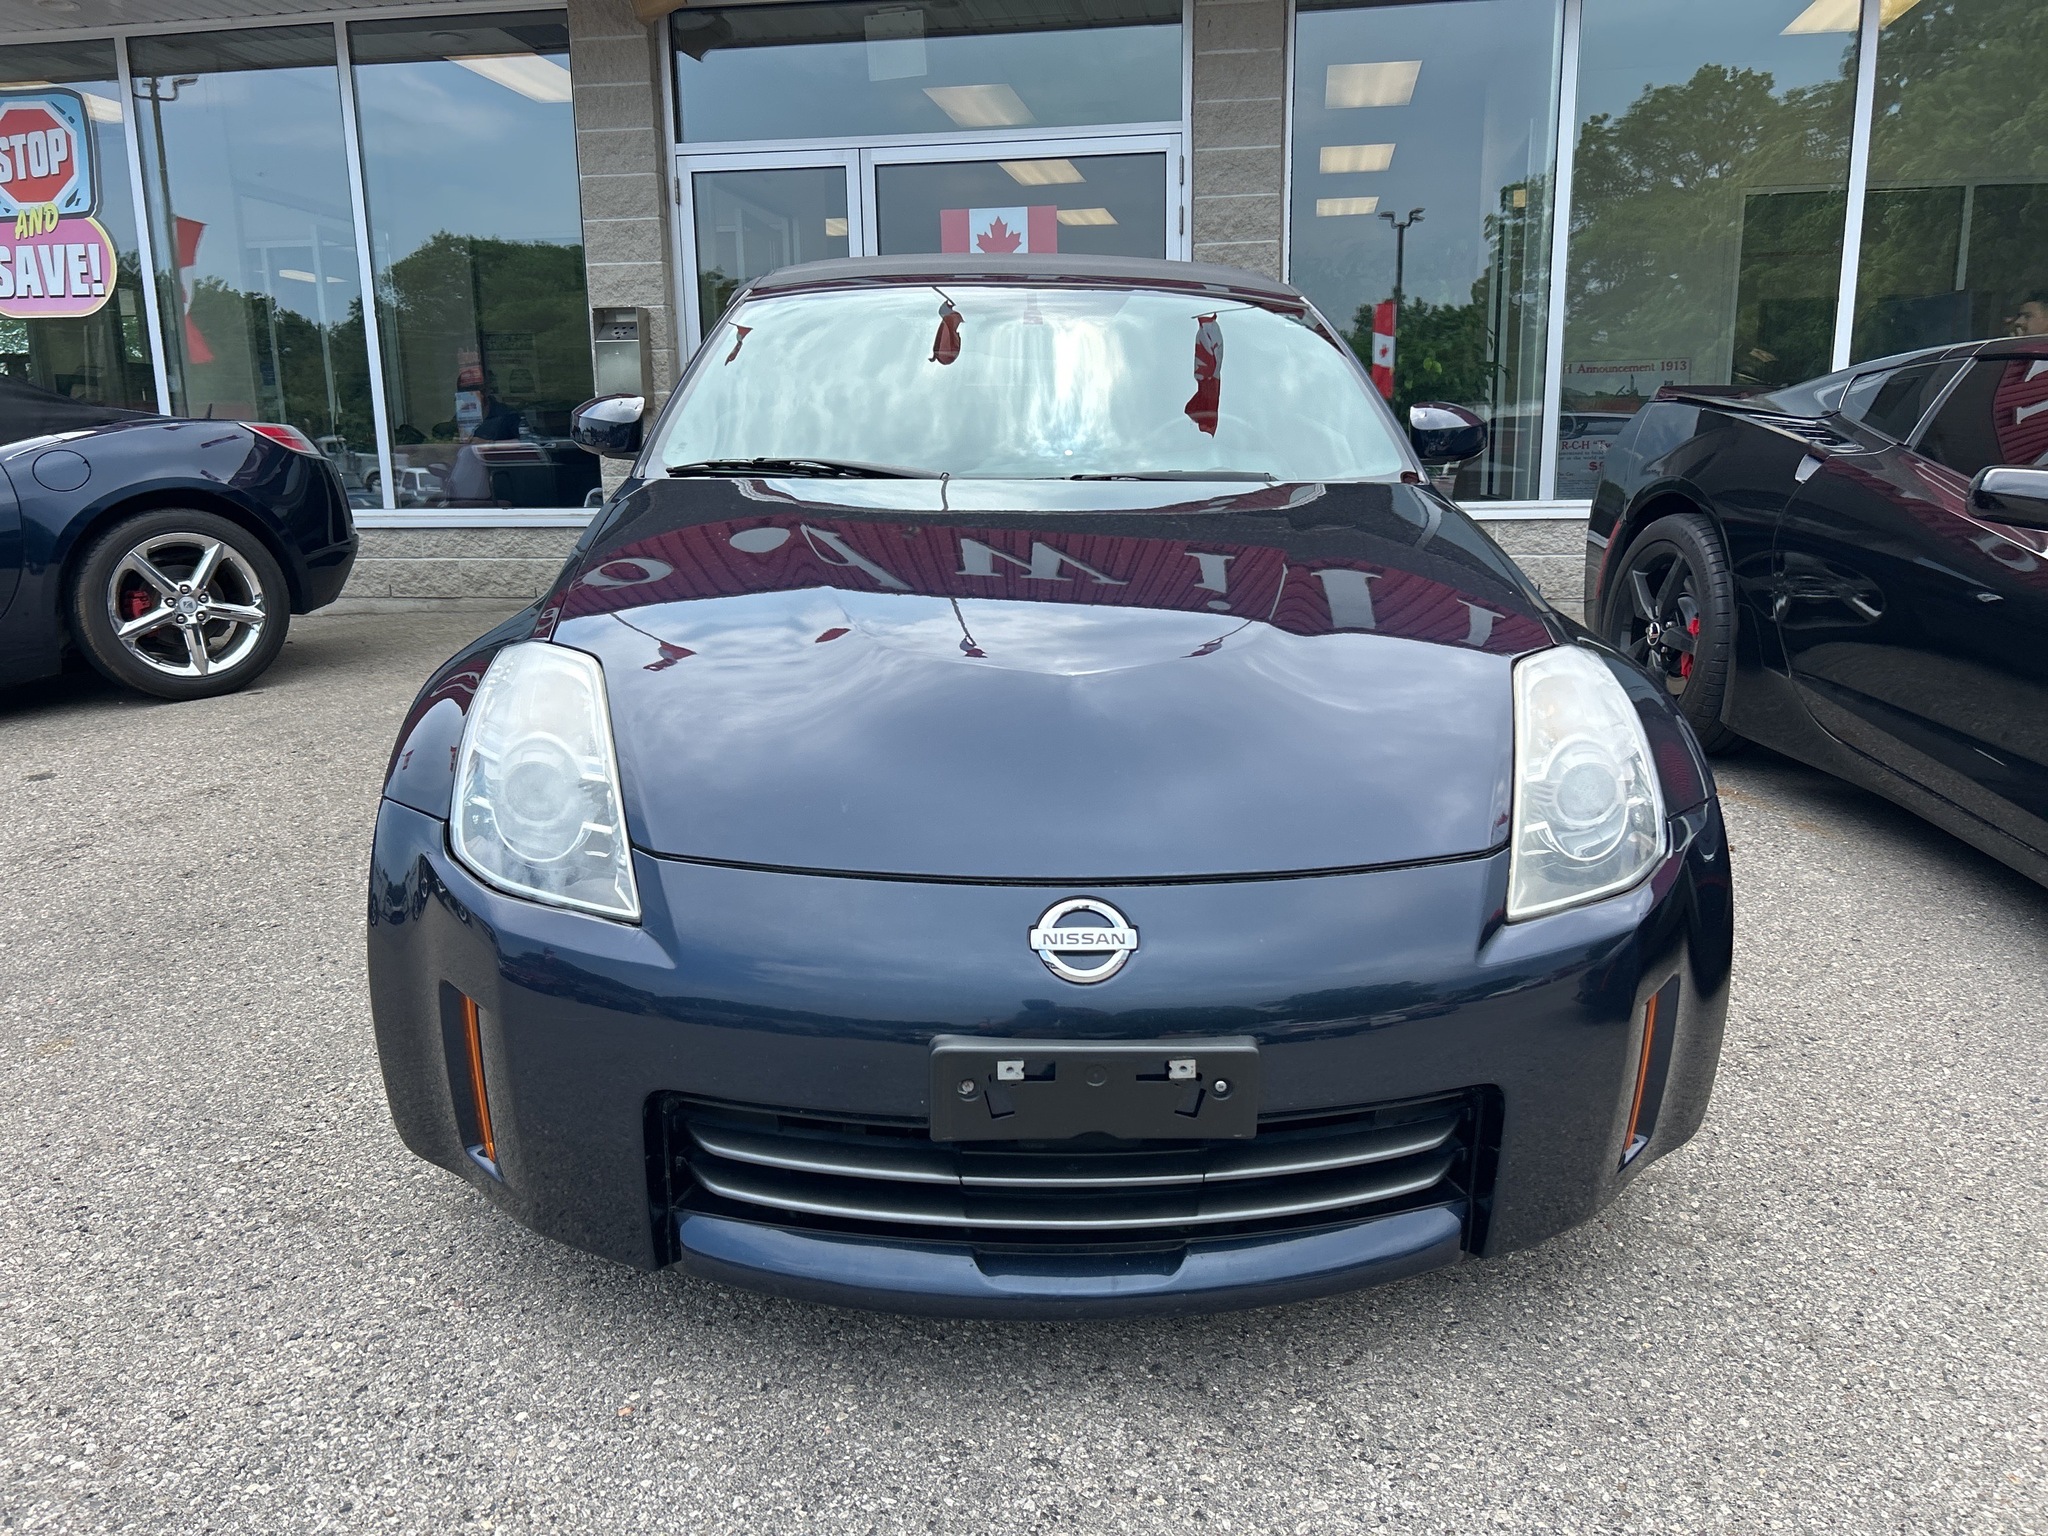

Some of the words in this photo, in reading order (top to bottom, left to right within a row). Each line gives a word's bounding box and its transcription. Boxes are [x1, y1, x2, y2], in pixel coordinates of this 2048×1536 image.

[0, 127, 68, 183] STOP
[15, 202, 59, 240] AND
[0, 243, 106, 299] SAVE!
[1577, 362, 1655, 374] Announcement
[1660, 360, 1688, 372] 1913
[1560, 440, 1590, 450] R-C-H
[1042, 933, 1126, 945] NISSAN
